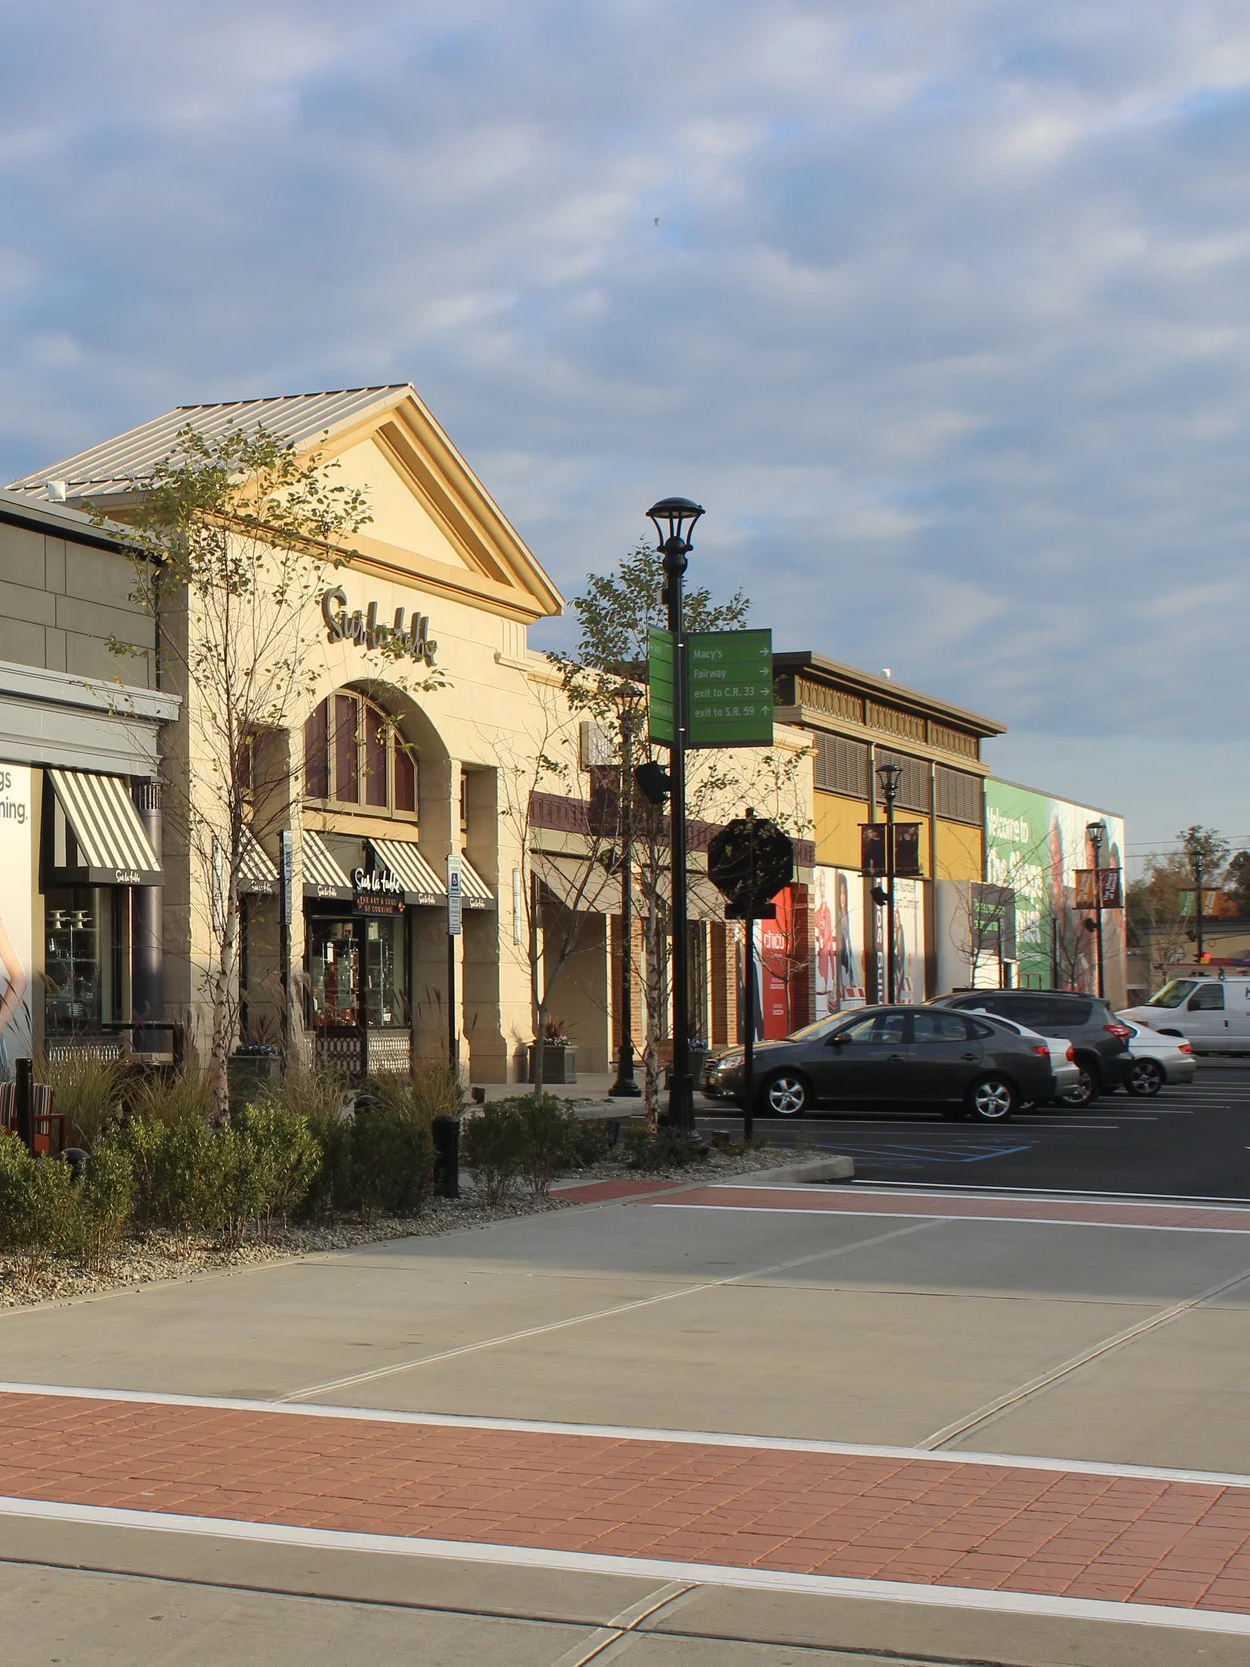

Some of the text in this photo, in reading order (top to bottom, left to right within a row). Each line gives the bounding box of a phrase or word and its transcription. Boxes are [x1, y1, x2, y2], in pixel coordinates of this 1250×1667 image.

[694, 649, 723, 660] Macy's
[694, 669, 726, 680] Fairway
[694, 686, 755, 698] exit to C.R. 33
[695, 706, 755, 718] exit to S.R. 59
[355, 868, 370, 890] Sur
[372, 870, 381, 891] la
